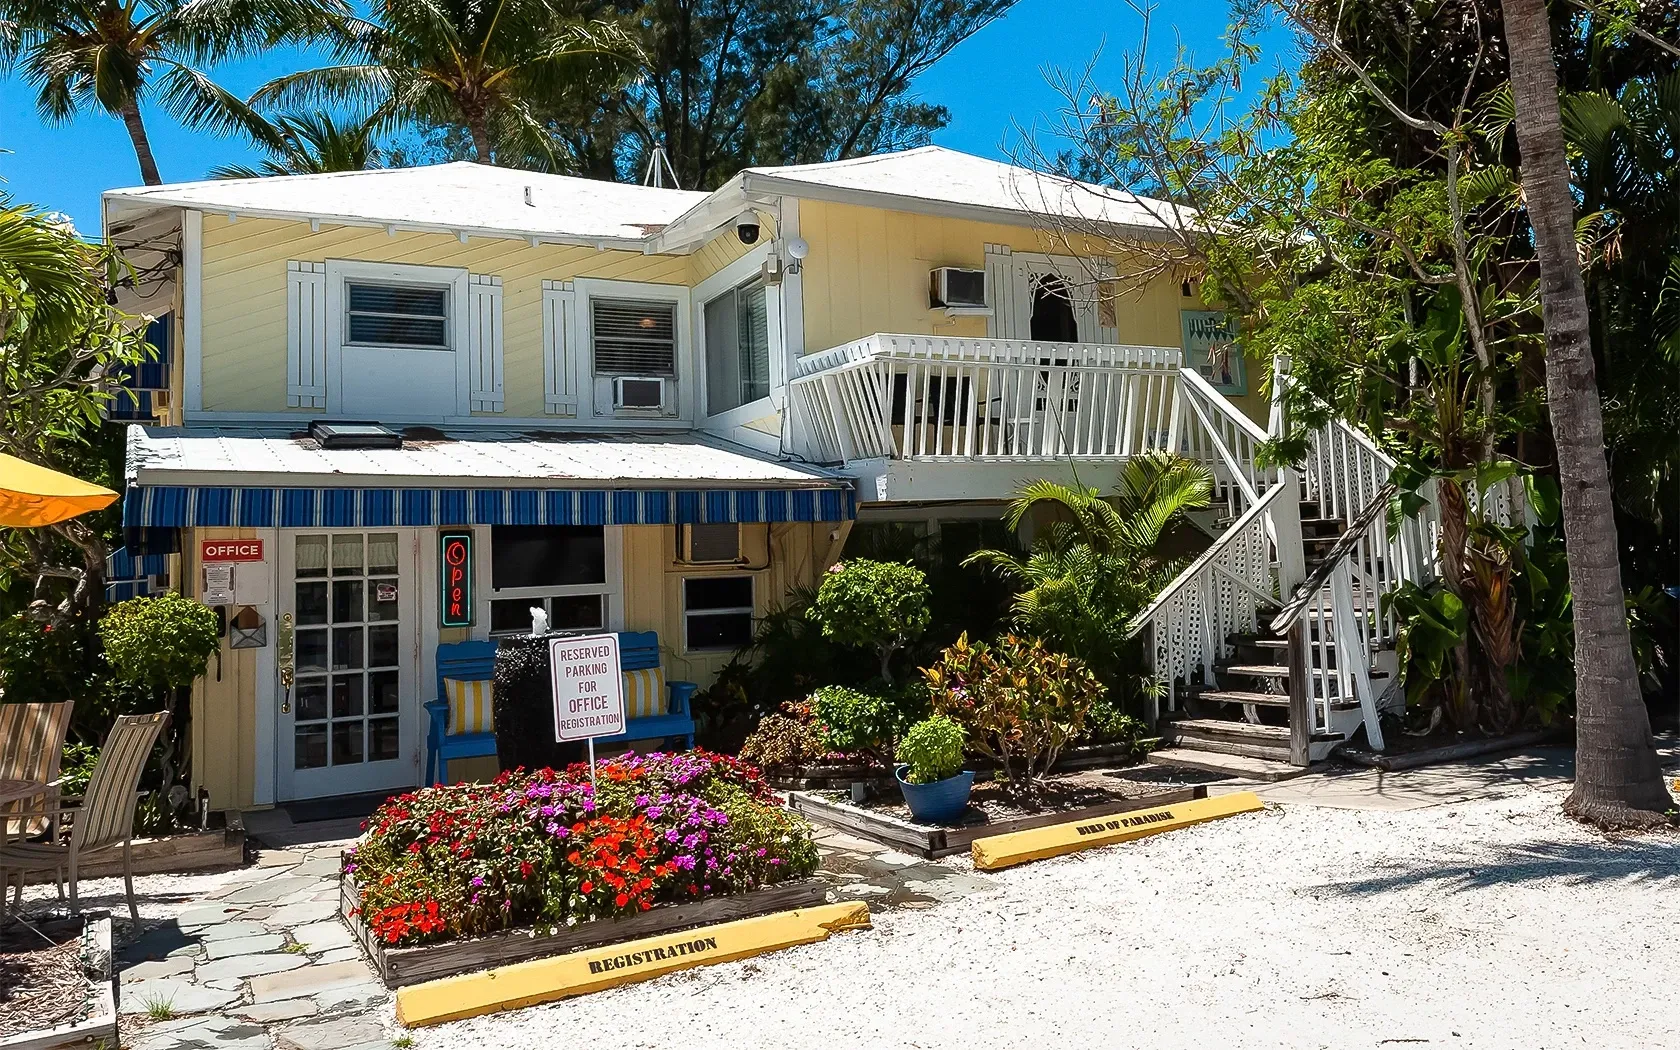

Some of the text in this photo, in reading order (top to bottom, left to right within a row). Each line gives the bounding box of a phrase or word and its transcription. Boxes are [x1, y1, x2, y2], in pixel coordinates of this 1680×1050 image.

[205, 545, 259, 556] OFFICE
[446, 541, 466, 616] Open
[560, 645, 610, 661] RESERVED
[565, 662, 608, 678] PARKING
[578, 680, 597, 693] FOR
[569, 695, 609, 713] OFFICE
[560, 713, 620, 730] REGISTRATION
[1076, 811, 1175, 836] BIRD OF PARADISE
[588, 936, 718, 974] REGISTRATION
